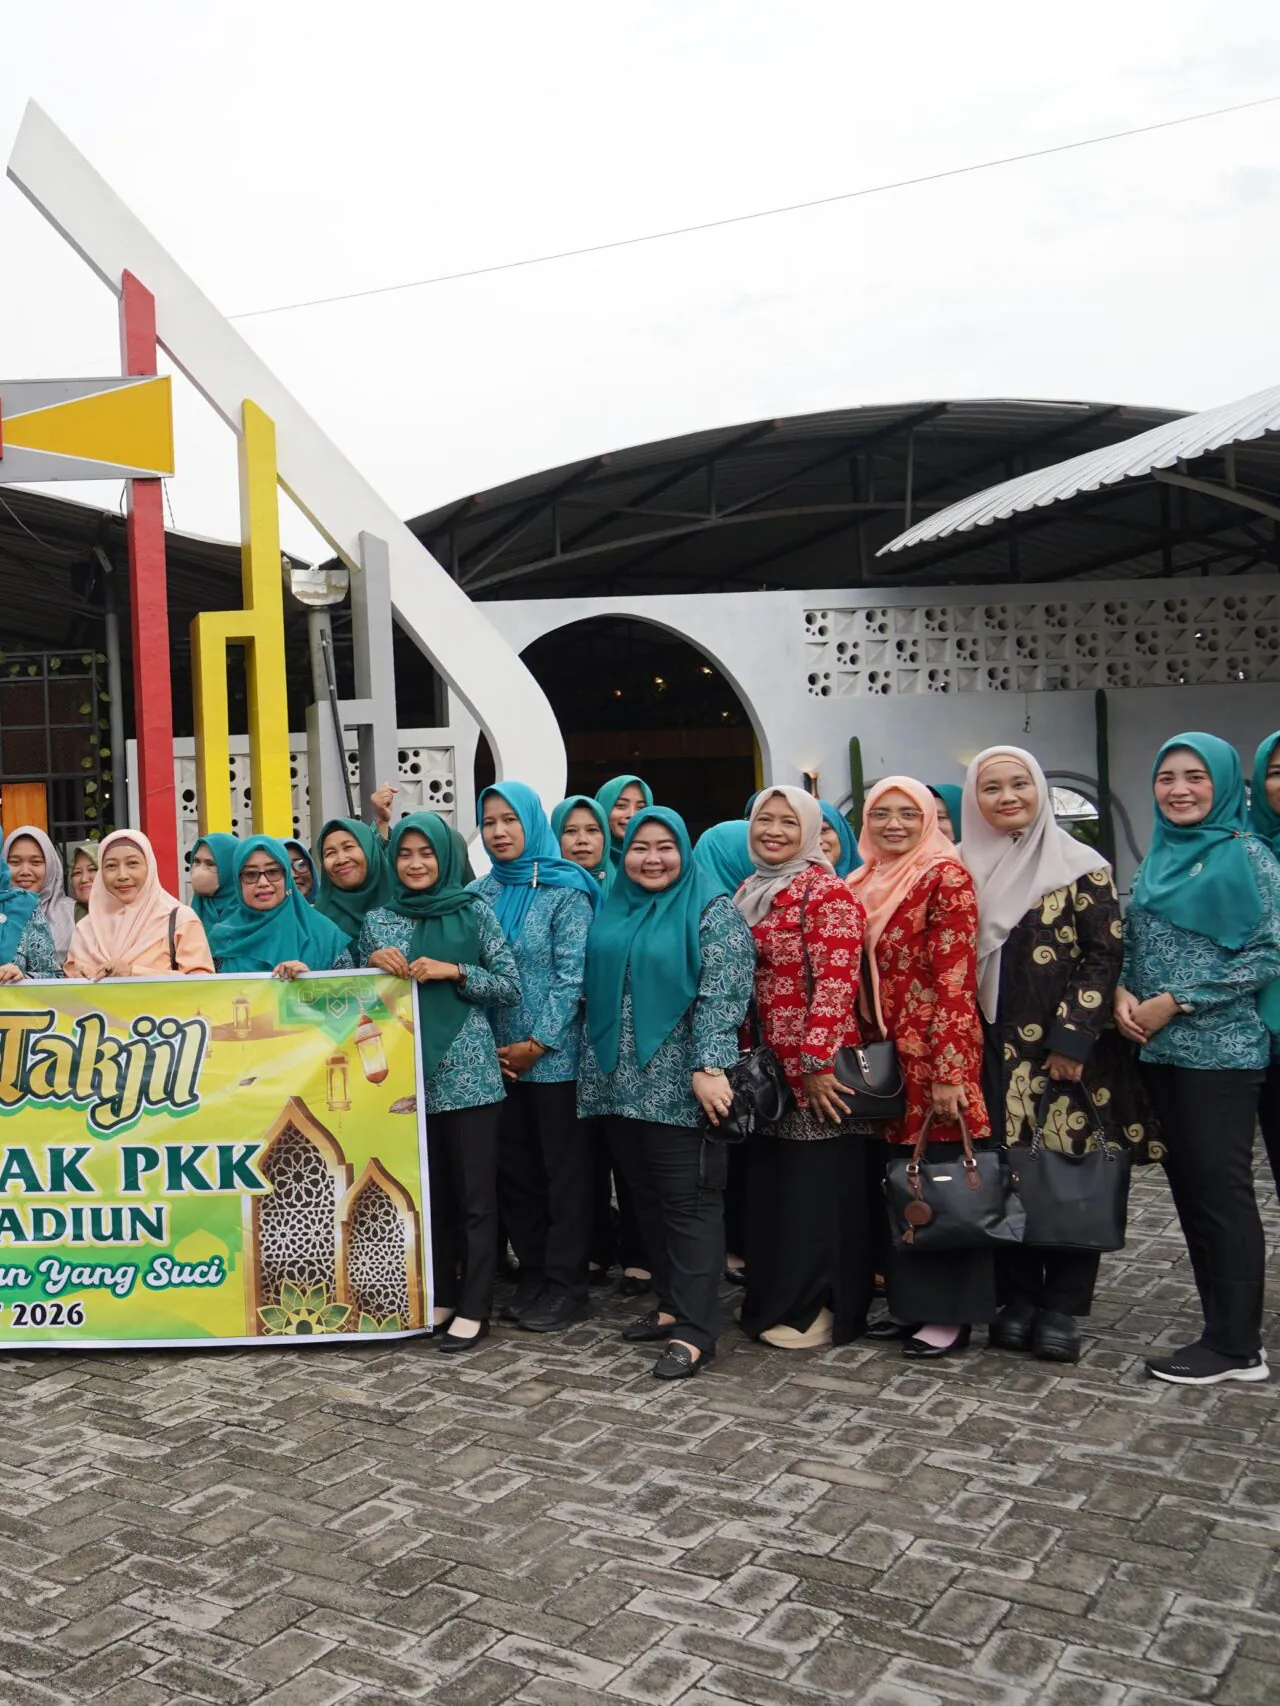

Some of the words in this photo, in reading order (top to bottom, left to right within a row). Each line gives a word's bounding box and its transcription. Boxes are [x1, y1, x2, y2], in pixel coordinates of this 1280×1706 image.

[121, 1145, 262, 1191] PKK
[38, 1257, 138, 1295] Yang
[145, 1256, 223, 1287] Suci
[12, 1302, 85, 1328] 2026
